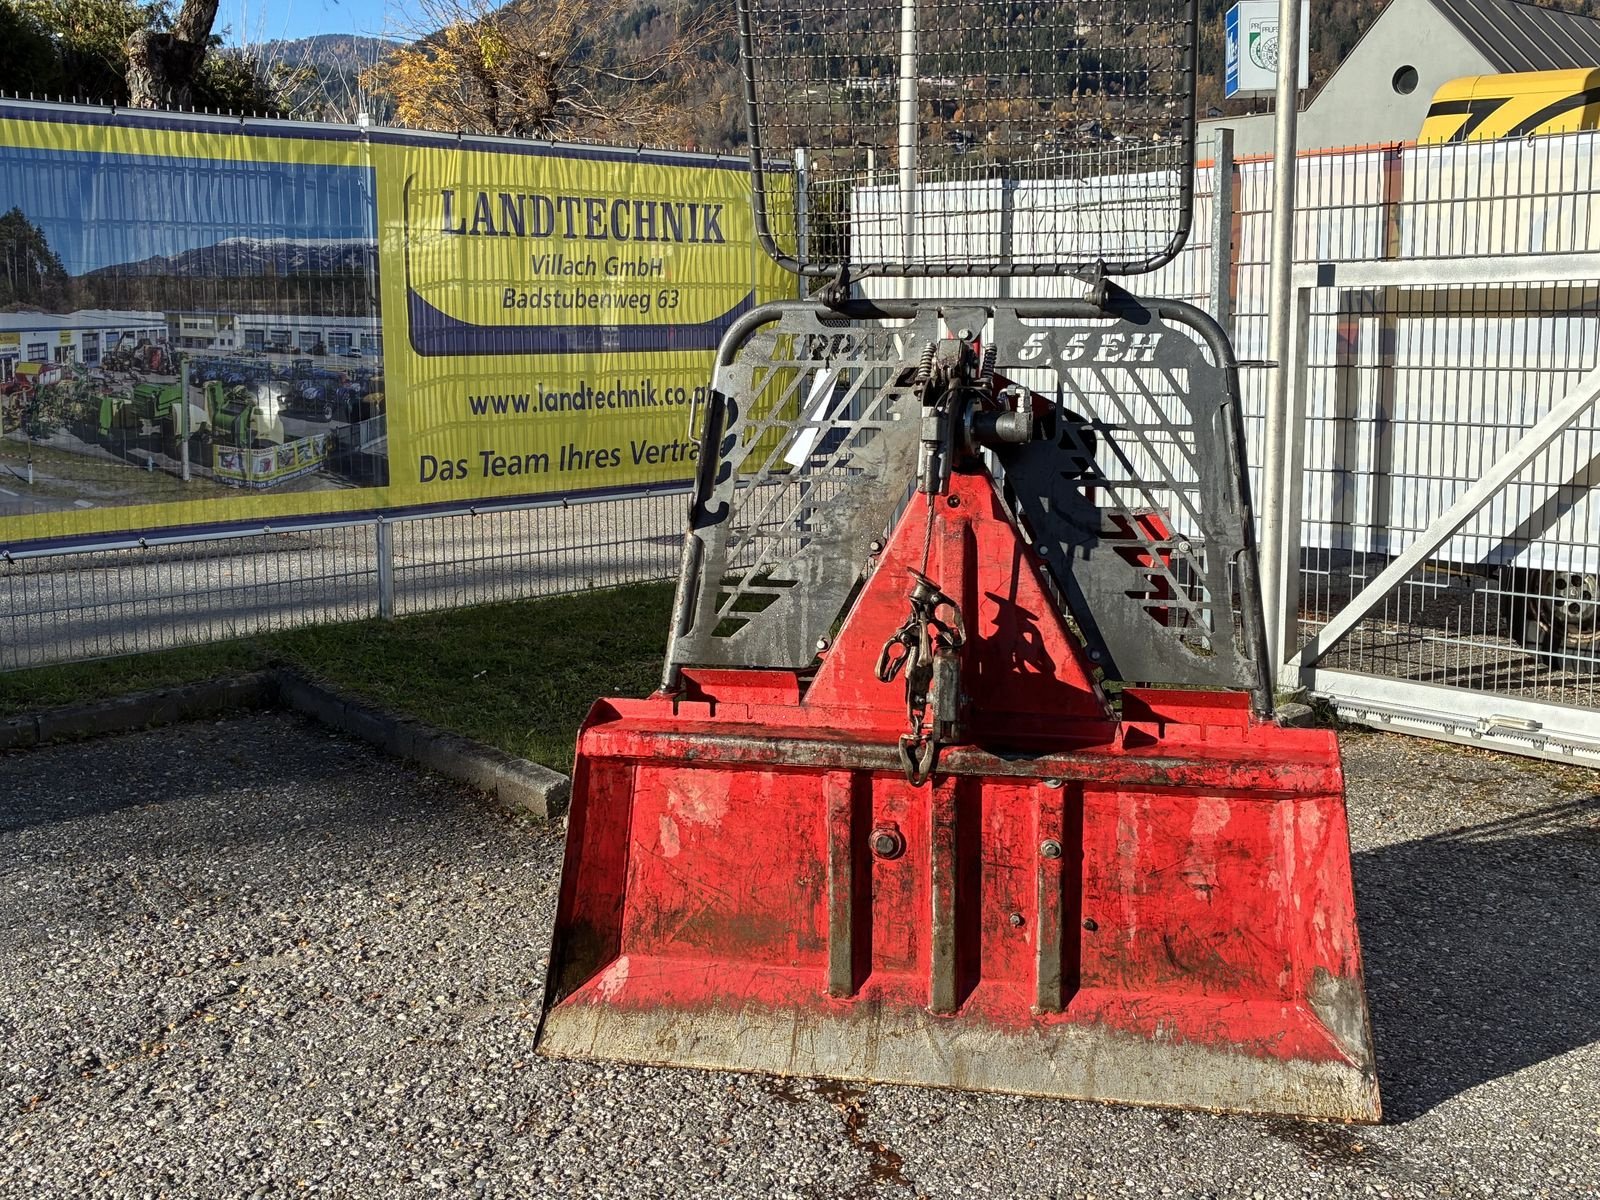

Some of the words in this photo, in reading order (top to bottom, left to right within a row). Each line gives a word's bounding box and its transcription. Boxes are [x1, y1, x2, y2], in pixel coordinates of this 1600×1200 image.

[441, 189, 726, 244] LANDTECHNIK
[530, 253, 597, 276] Villach
[603, 255, 664, 277] GmbH
[502, 287, 653, 313] Badstubenweg
[656, 288, 680, 309] 63
[419, 453, 468, 483] Das
[478, 448, 551, 478] Team
[559, 443, 621, 472] Ihres
